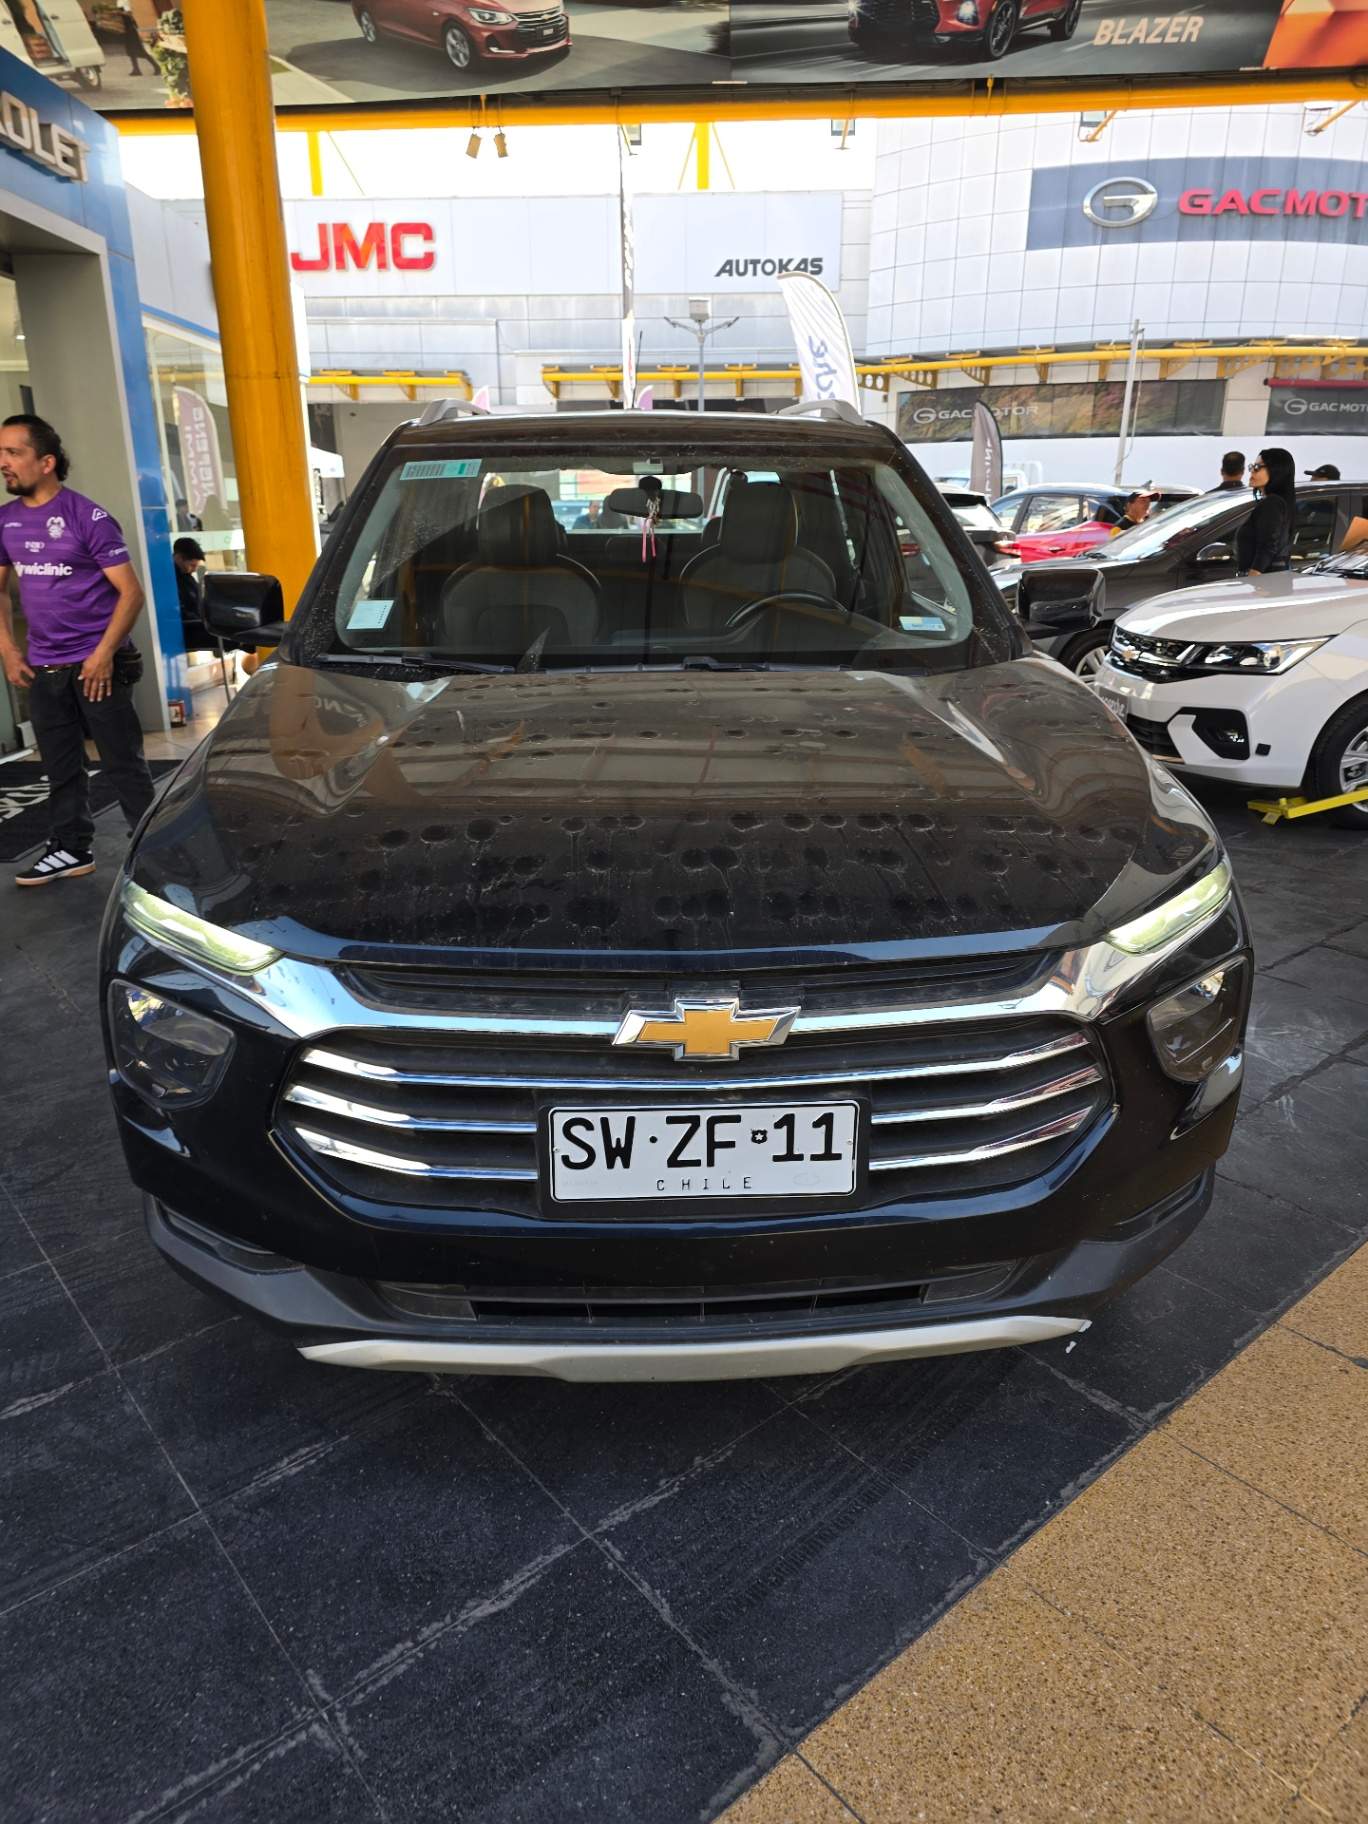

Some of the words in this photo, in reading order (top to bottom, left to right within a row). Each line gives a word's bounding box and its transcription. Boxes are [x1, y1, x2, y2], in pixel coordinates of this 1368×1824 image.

[1093, 15, 1204, 46] BLAZER
[0, 90, 91, 183] OLET
[291, 222, 435, 271] JMC
[714, 257, 824, 278] AUTOKAS
[656, 1176, 752, 1192] CHILE
